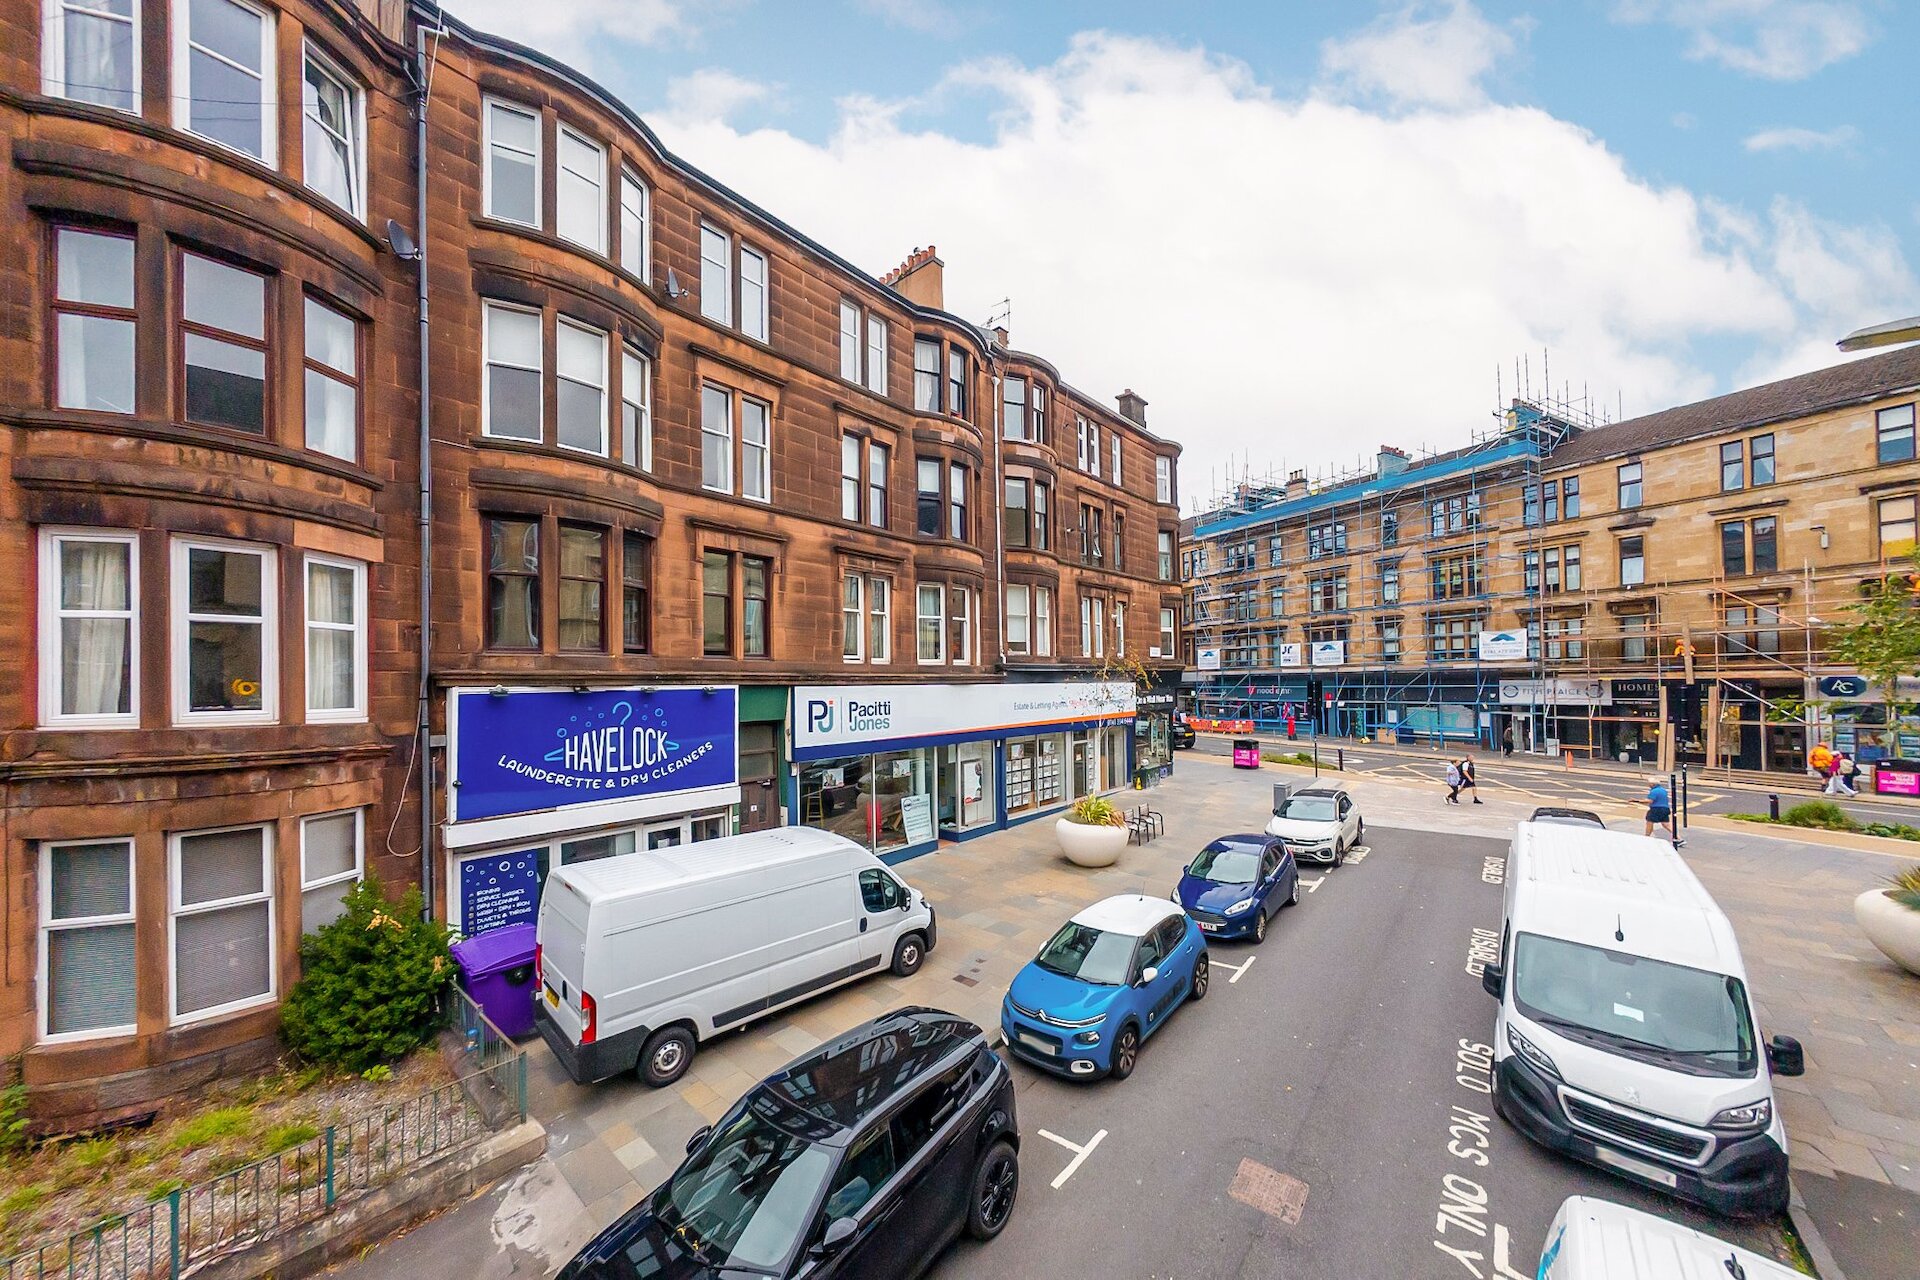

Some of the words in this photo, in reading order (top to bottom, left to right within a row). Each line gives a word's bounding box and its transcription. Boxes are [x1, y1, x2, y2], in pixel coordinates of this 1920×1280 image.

[1547, 688, 1581, 696] PAICE
[1831, 680, 1854, 693] AC
[849, 701, 891, 722] Pacitti
[850, 716, 890, 731] Jones
[498, 755, 602, 789] LAUNDERETTE
[605, 779, 615, 788] &
[621, 773, 648, 787] DRY
[652, 741, 713, 779] CLEANERS
[565, 726, 667, 773] HAVELOCK
[1456, 1038, 1494, 1094] SOLO
[1447, 1105, 1490, 1167] MCS
[1434, 1173, 1488, 1280] ONLY
